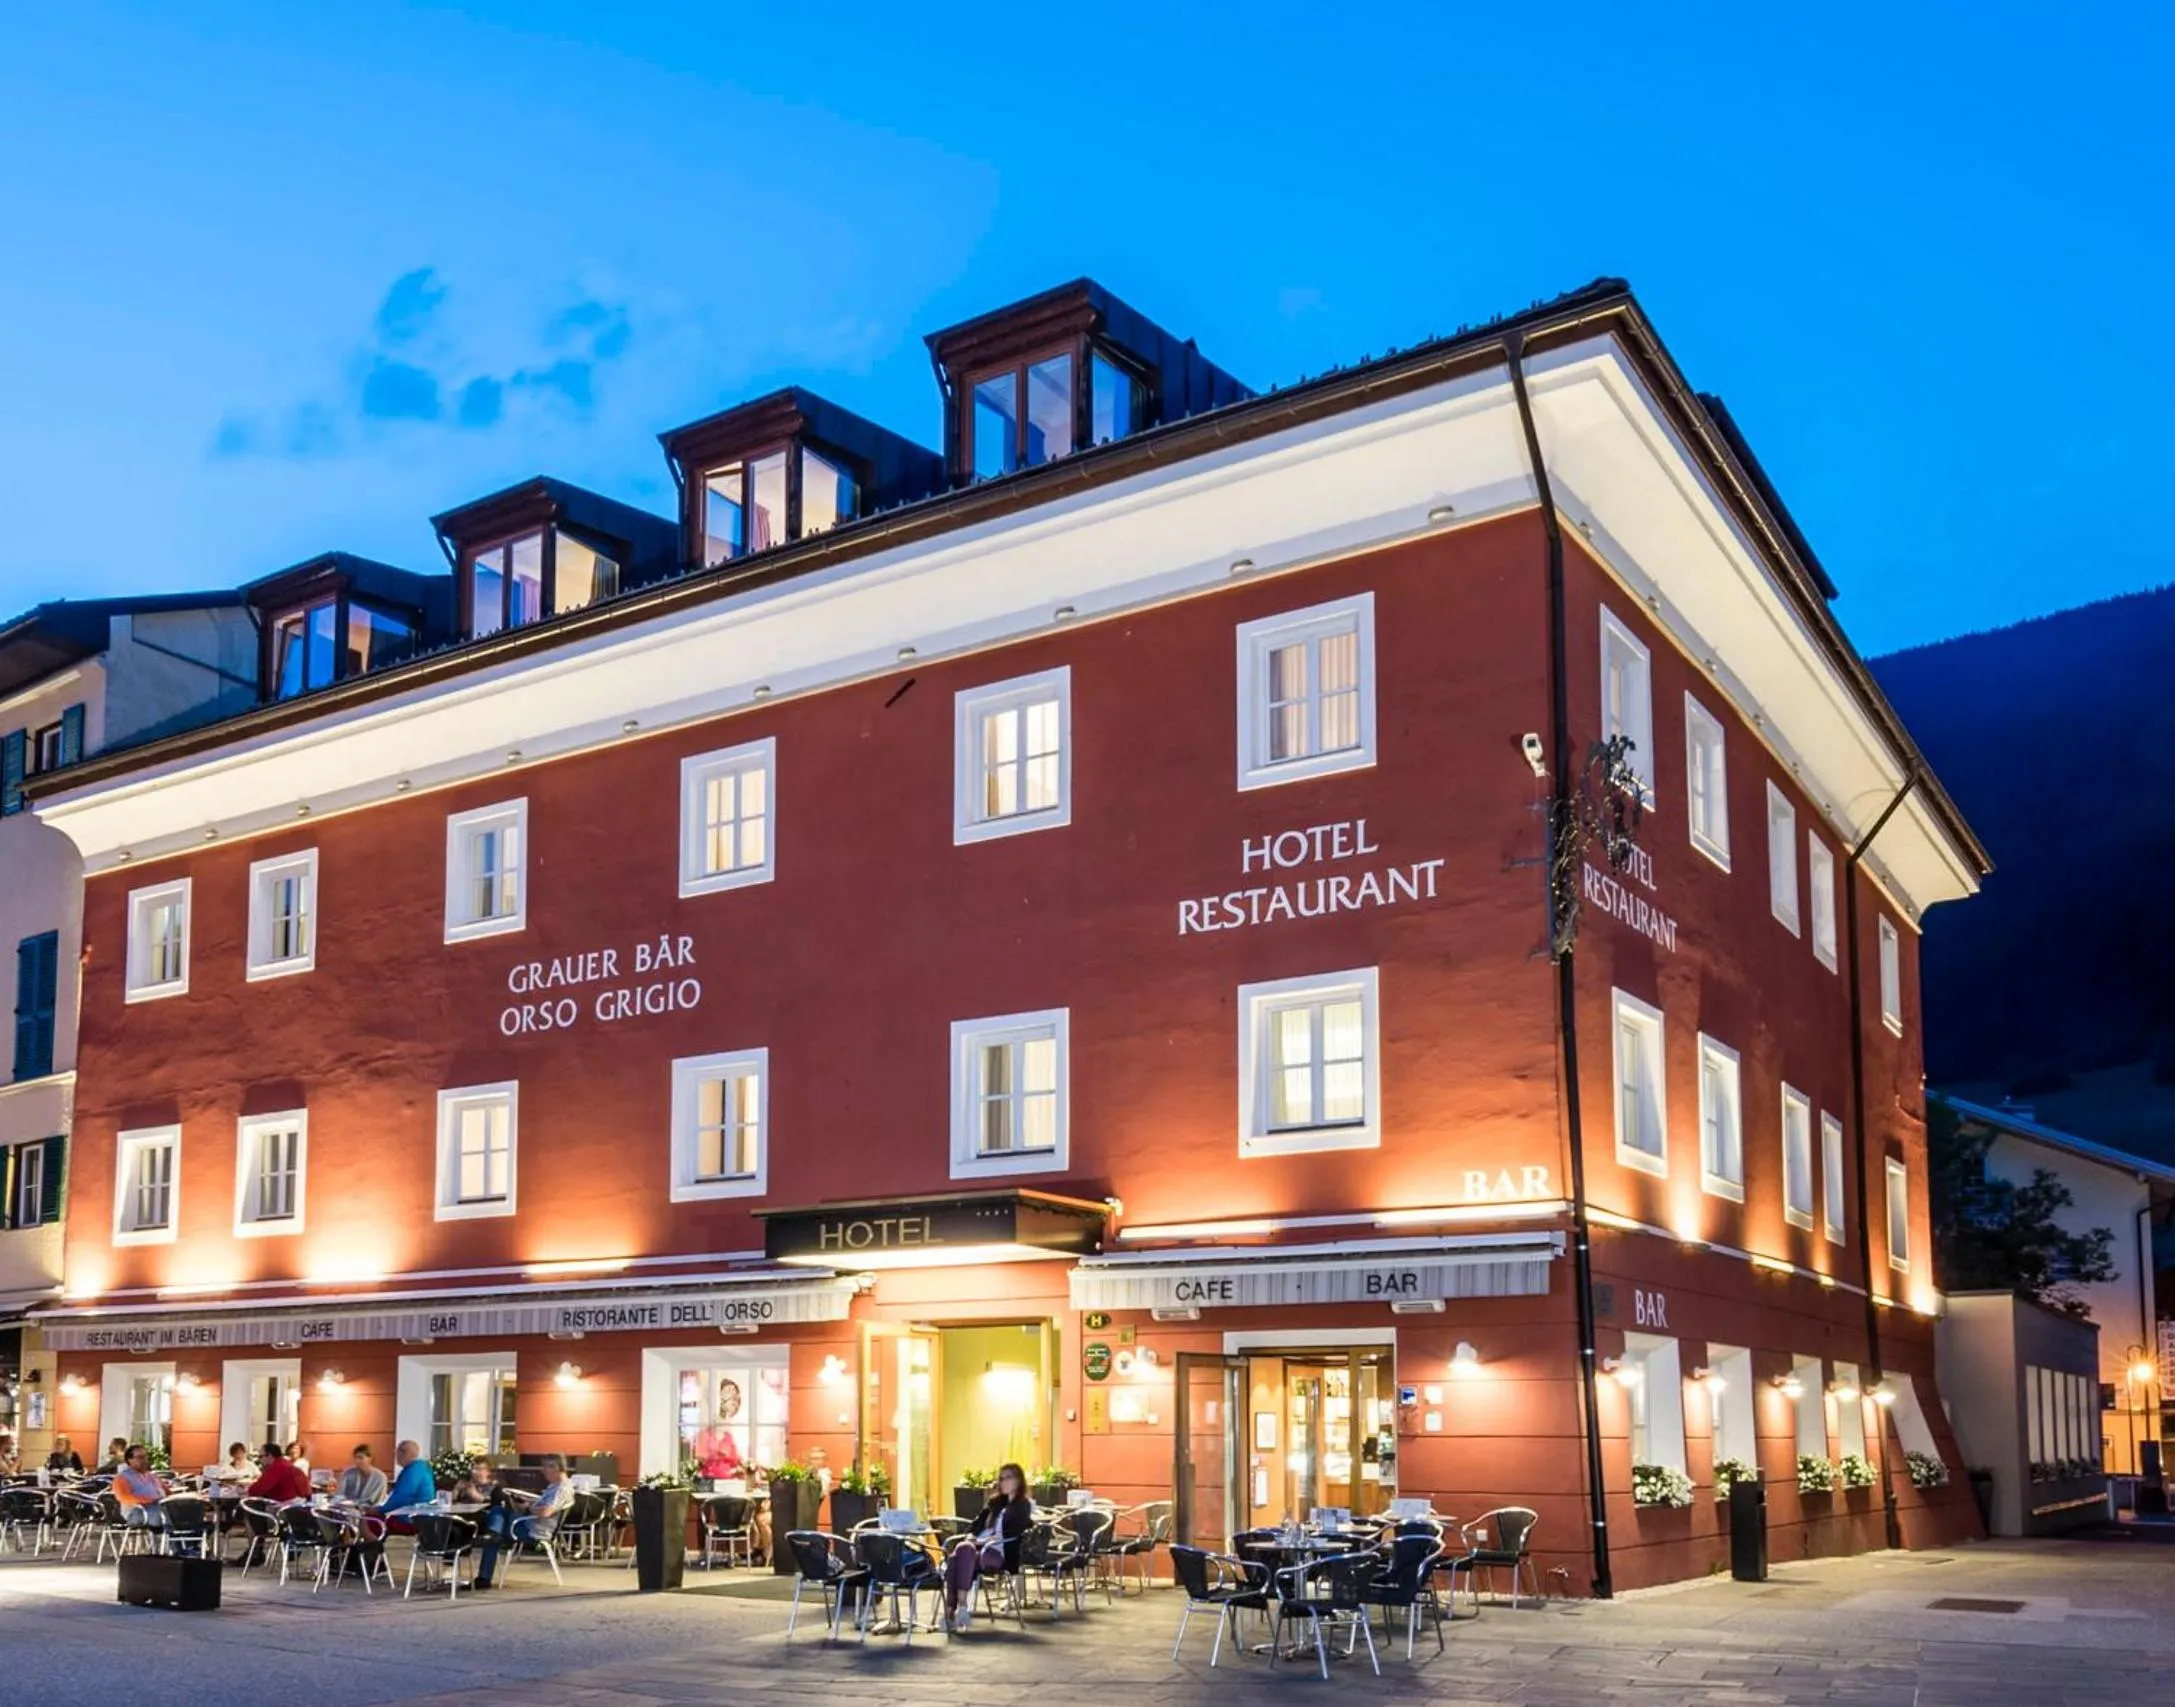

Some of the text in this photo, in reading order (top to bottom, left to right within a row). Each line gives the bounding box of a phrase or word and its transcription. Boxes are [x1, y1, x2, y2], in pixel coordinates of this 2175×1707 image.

[1242, 819, 1379, 873] HOTEL
[1178, 858, 1445, 935] RESTAURANT
[1584, 861, 1678, 953] RESTAURANT
[508, 934, 696, 994] GRAUER BÄR
[500, 978, 702, 1036] ORSO GRIGIO
[1462, 1165, 1551, 1200] BAR
[820, 1217, 943, 1250] HOTEL
[1175, 1273, 1418, 1301] CAFE BAR
[301, 1316, 458, 1338] CAFE BAR
[563, 1307, 659, 1328] RISTORANTE
[725, 1301, 774, 1321] ORSO
[1635, 1289, 1669, 1329] BAR
[87, 1330, 155, 1346] RESTAURANT
[160, 1329, 173, 1344] IM
